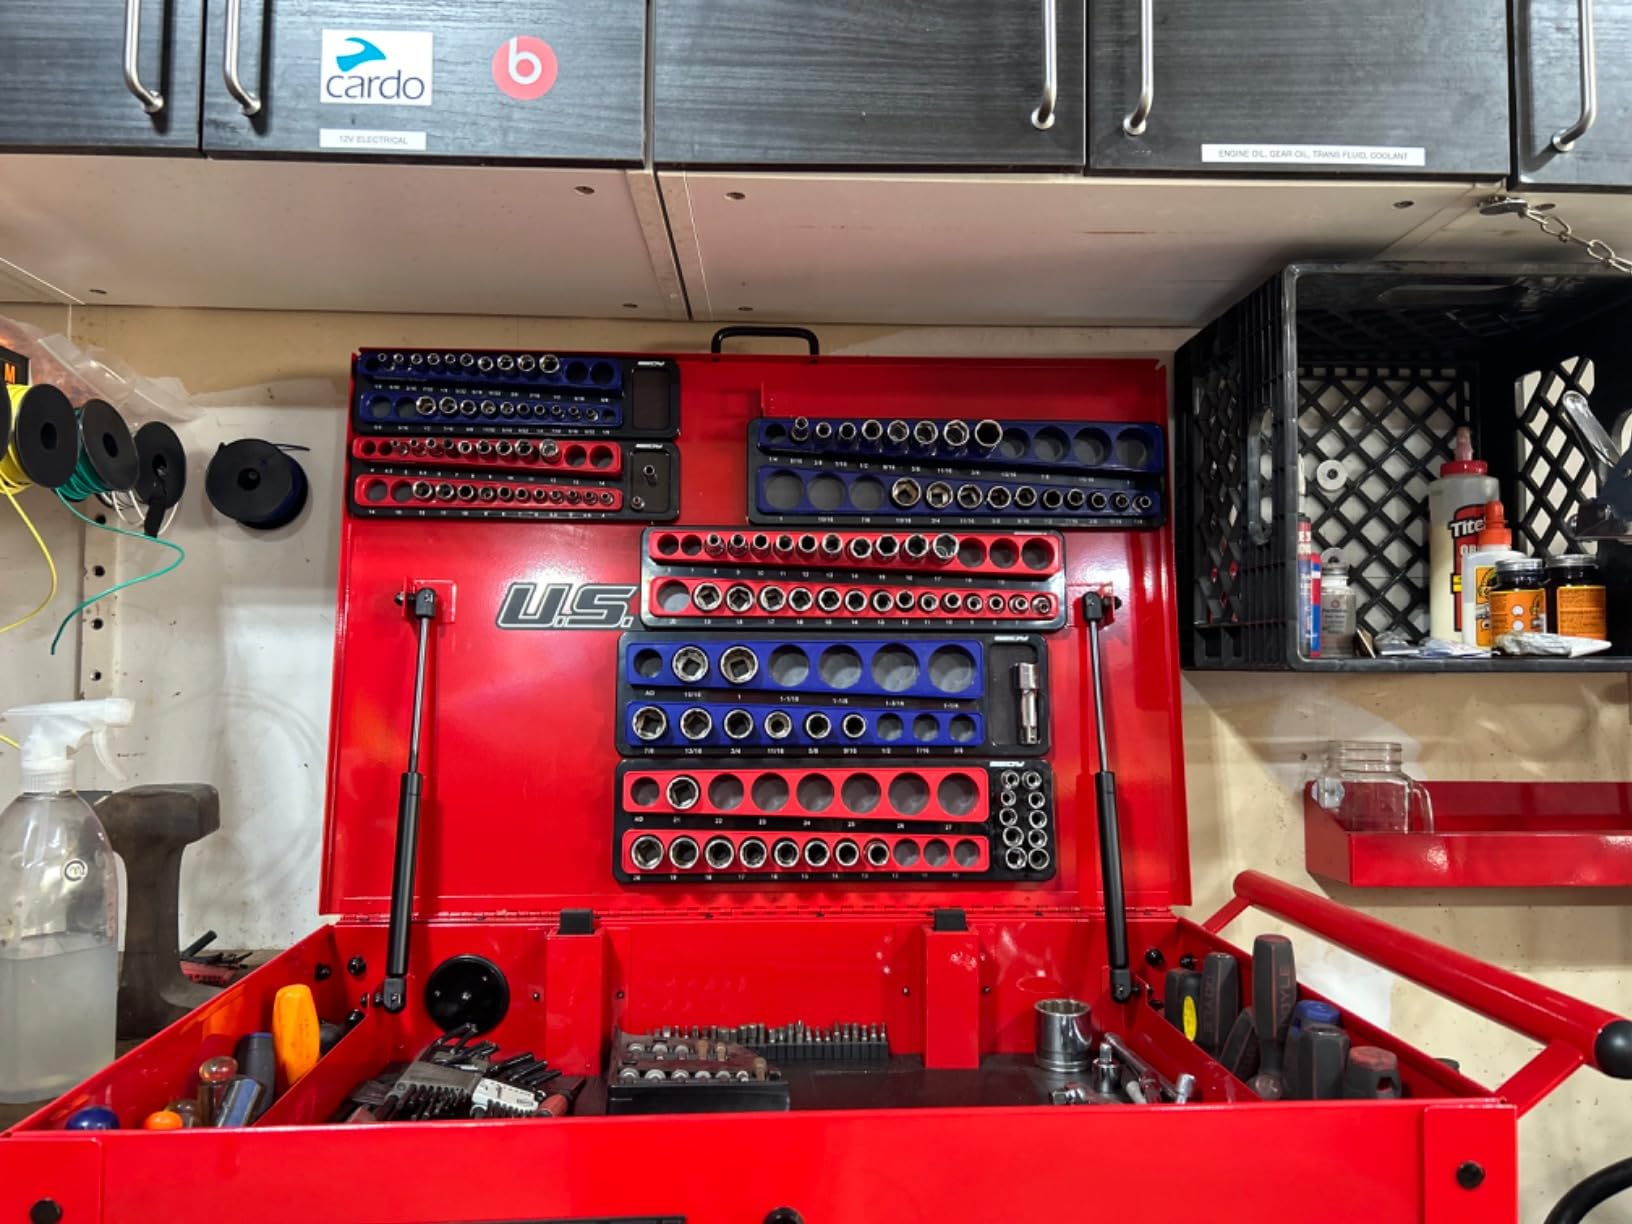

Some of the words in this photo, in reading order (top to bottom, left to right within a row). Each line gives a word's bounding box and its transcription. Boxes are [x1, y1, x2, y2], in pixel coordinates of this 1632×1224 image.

[326, 69, 425, 100] cardo
[338, 135, 354, 144] 12V
[356, 135, 409, 145] ELECTRICAL
[1218, 150, 1249, 158] ENGINE
[1270, 150, 1293, 159] GEAR
[1312, 151, 1340, 160] TRANS
[1370, 152, 1408, 161] COOLANT
[1450, 519, 1487, 538] Tite
[497, 582, 639, 629] U.S.
